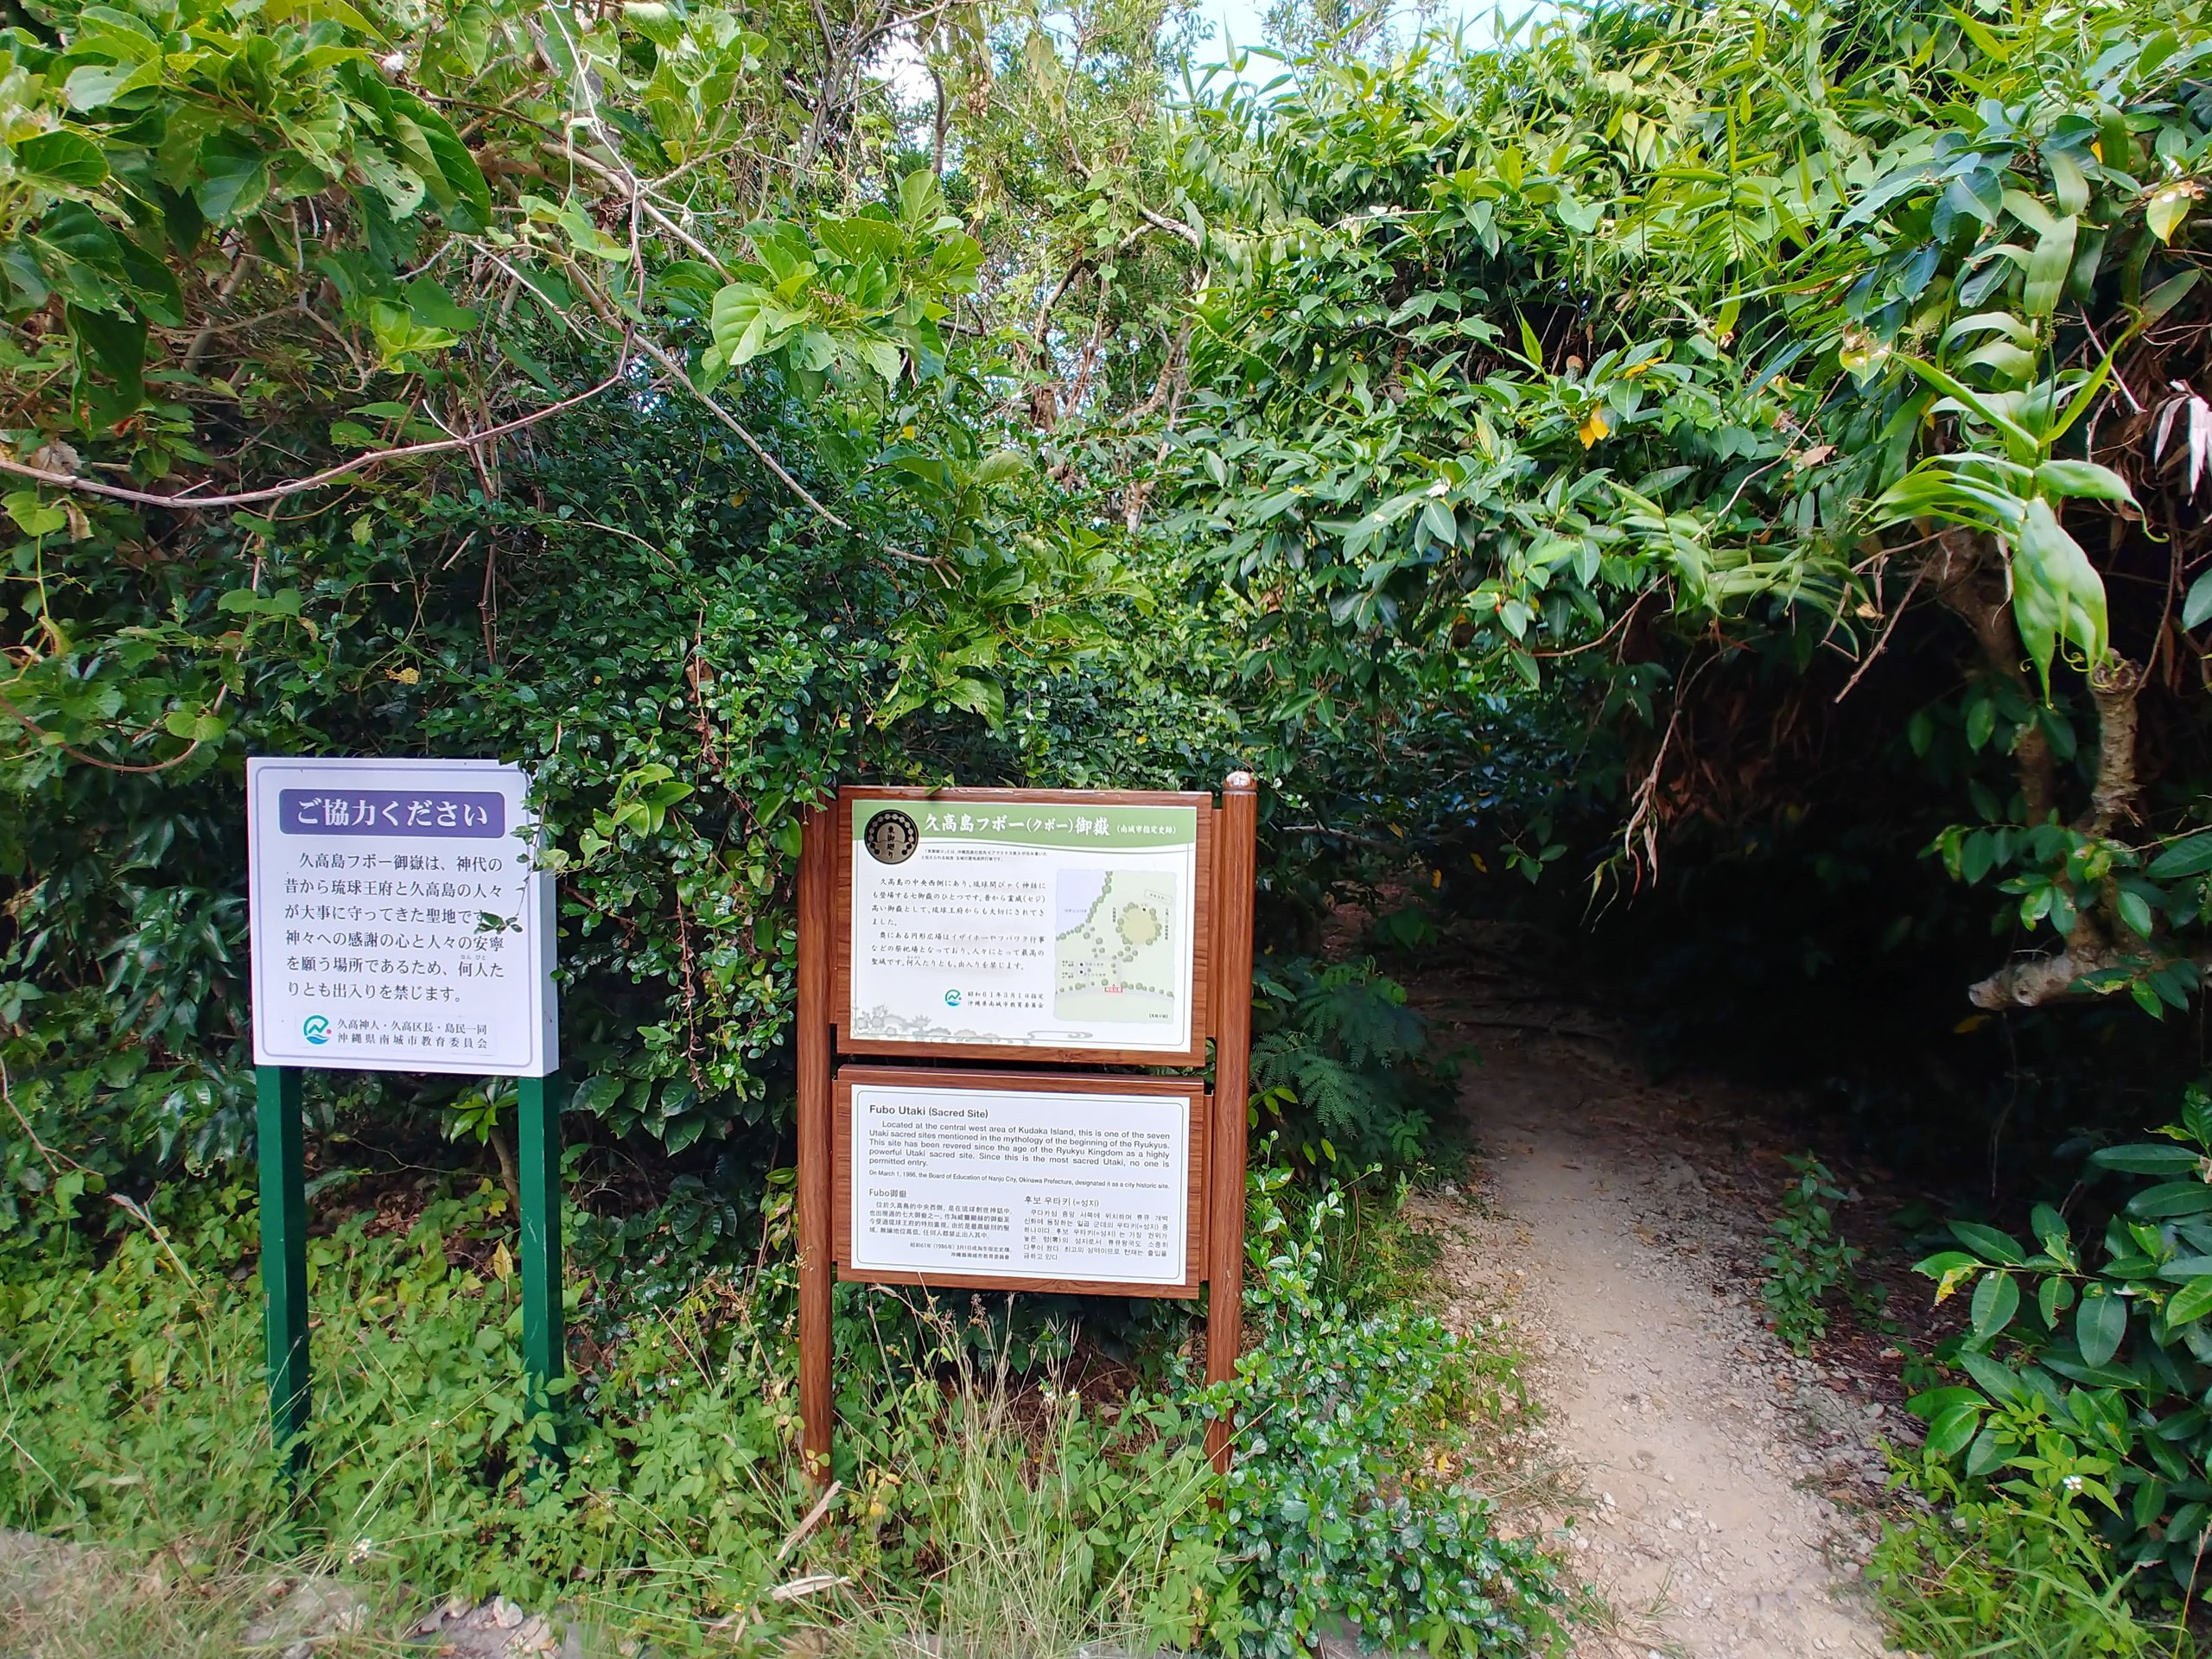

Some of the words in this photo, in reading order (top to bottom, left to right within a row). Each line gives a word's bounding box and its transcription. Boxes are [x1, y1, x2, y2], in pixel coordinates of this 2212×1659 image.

[298, 798, 487, 826] ご協力ください
[284, 878, 501, 898] 昔から琉球王府と久高島の人々
[872, 918, 897, 926] ました。
[285, 929, 504, 951] 神々への感謝の心と人々の安寧
[287, 956, 504, 977] を願う場所であるため、何人た
[289, 982, 460, 1002] りとも出入りを禁じます。
[338, 1032, 487, 1049] 沖縄県南城市教育委員会
[869, 1104, 895, 1114] Fubo
[899, 1105, 925, 1116] Utaki
[928, 1106, 964, 1117] (Sacred
[967, 1109, 988, 1119] Site)
[882, 1120, 912, 1128] Located
[1018, 1126, 1047, 1135] Kudaka
[1050, 1128, 1076, 1136] Island,
[1002, 1135, 1043, 1145] mythology
[1069, 1137, 1108, 1147] beginning
[1134, 1141, 1169, 1150] Ryukyus.
[979, 1152, 1001, 1160] Since
[1103, 1158, 1125, 1166] Utaki,
[1056, 1147, 1084, 1156] Ryukyu
[1088, 1147, 1122, 1157] Kingdom
[1146, 1150, 1169, 1160] highly
[907, 1159, 928, 1167] entry.
